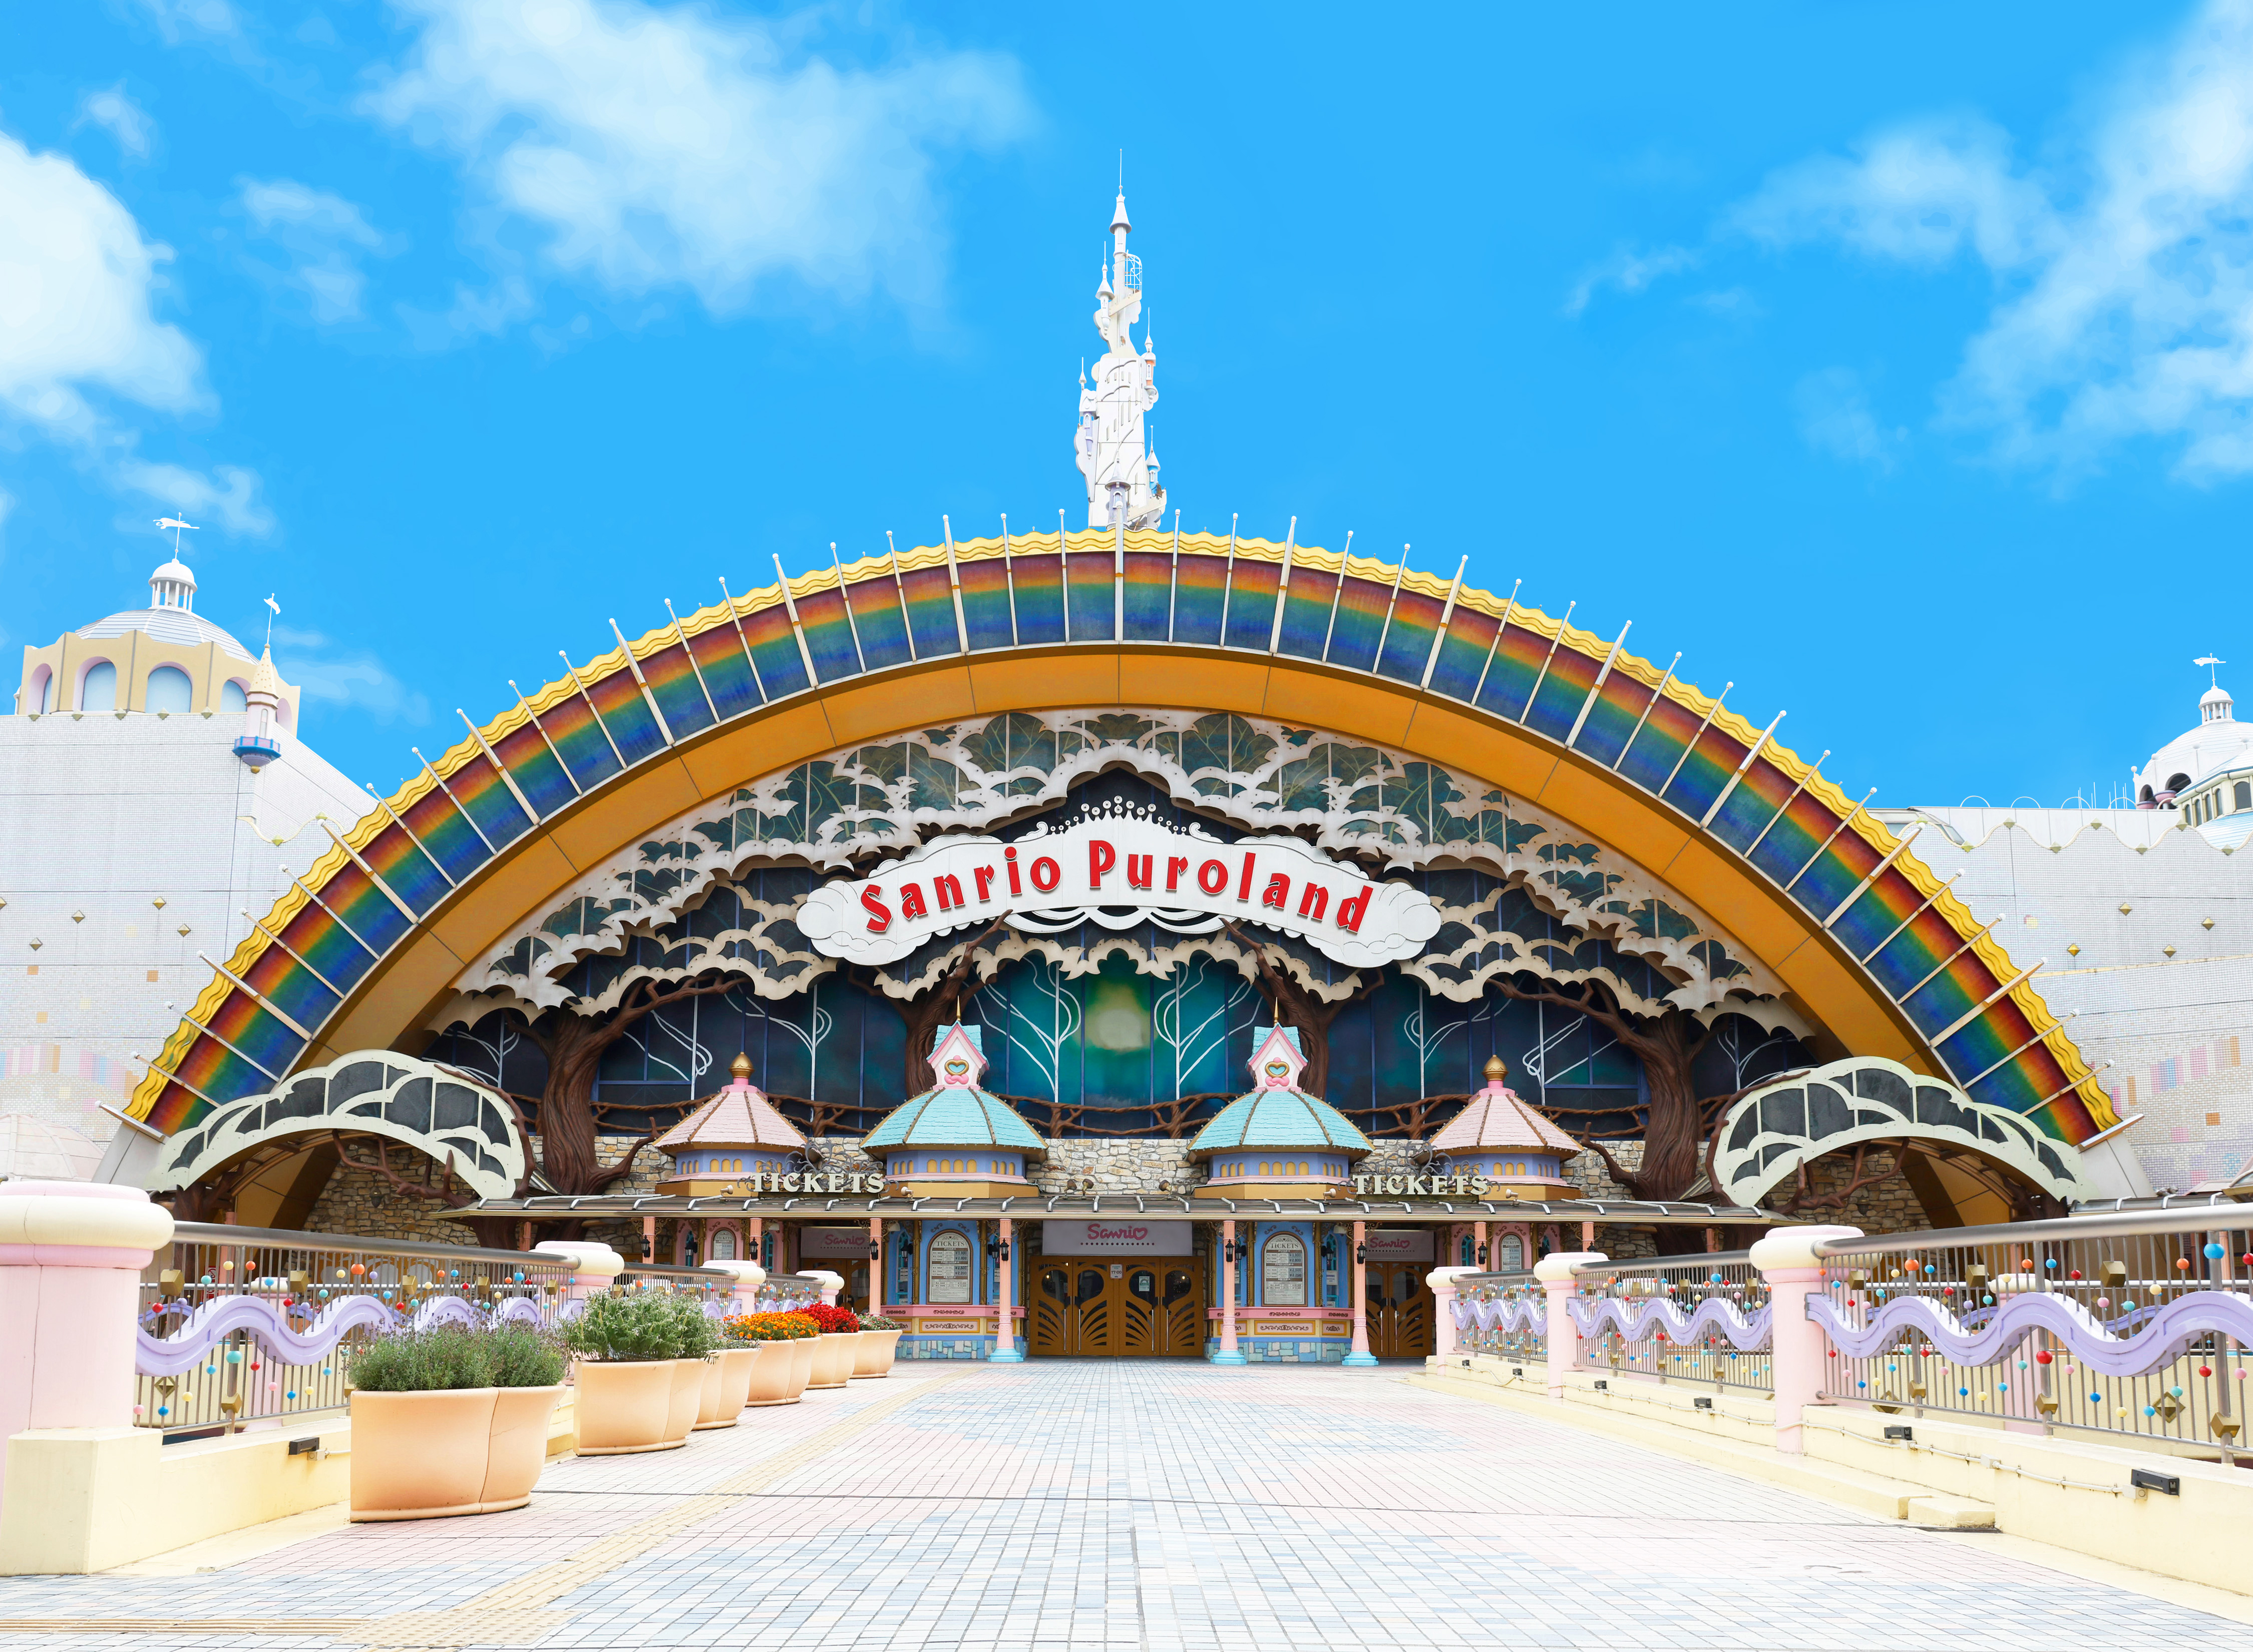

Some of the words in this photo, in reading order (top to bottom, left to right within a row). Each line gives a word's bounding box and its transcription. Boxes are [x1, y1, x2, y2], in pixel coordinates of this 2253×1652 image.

[860, 846, 1061, 933] Sanrio
[1088, 840, 1373, 934] Puroland
[750, 1172, 885, 1193] TICKETS
[1352, 1174, 1488, 1195] TICKETS
[825, 1234, 865, 1246] Sanrio
[1087, 1223, 1148, 1241] Sanrio
[1369, 1237, 1410, 1249] Sanrio
